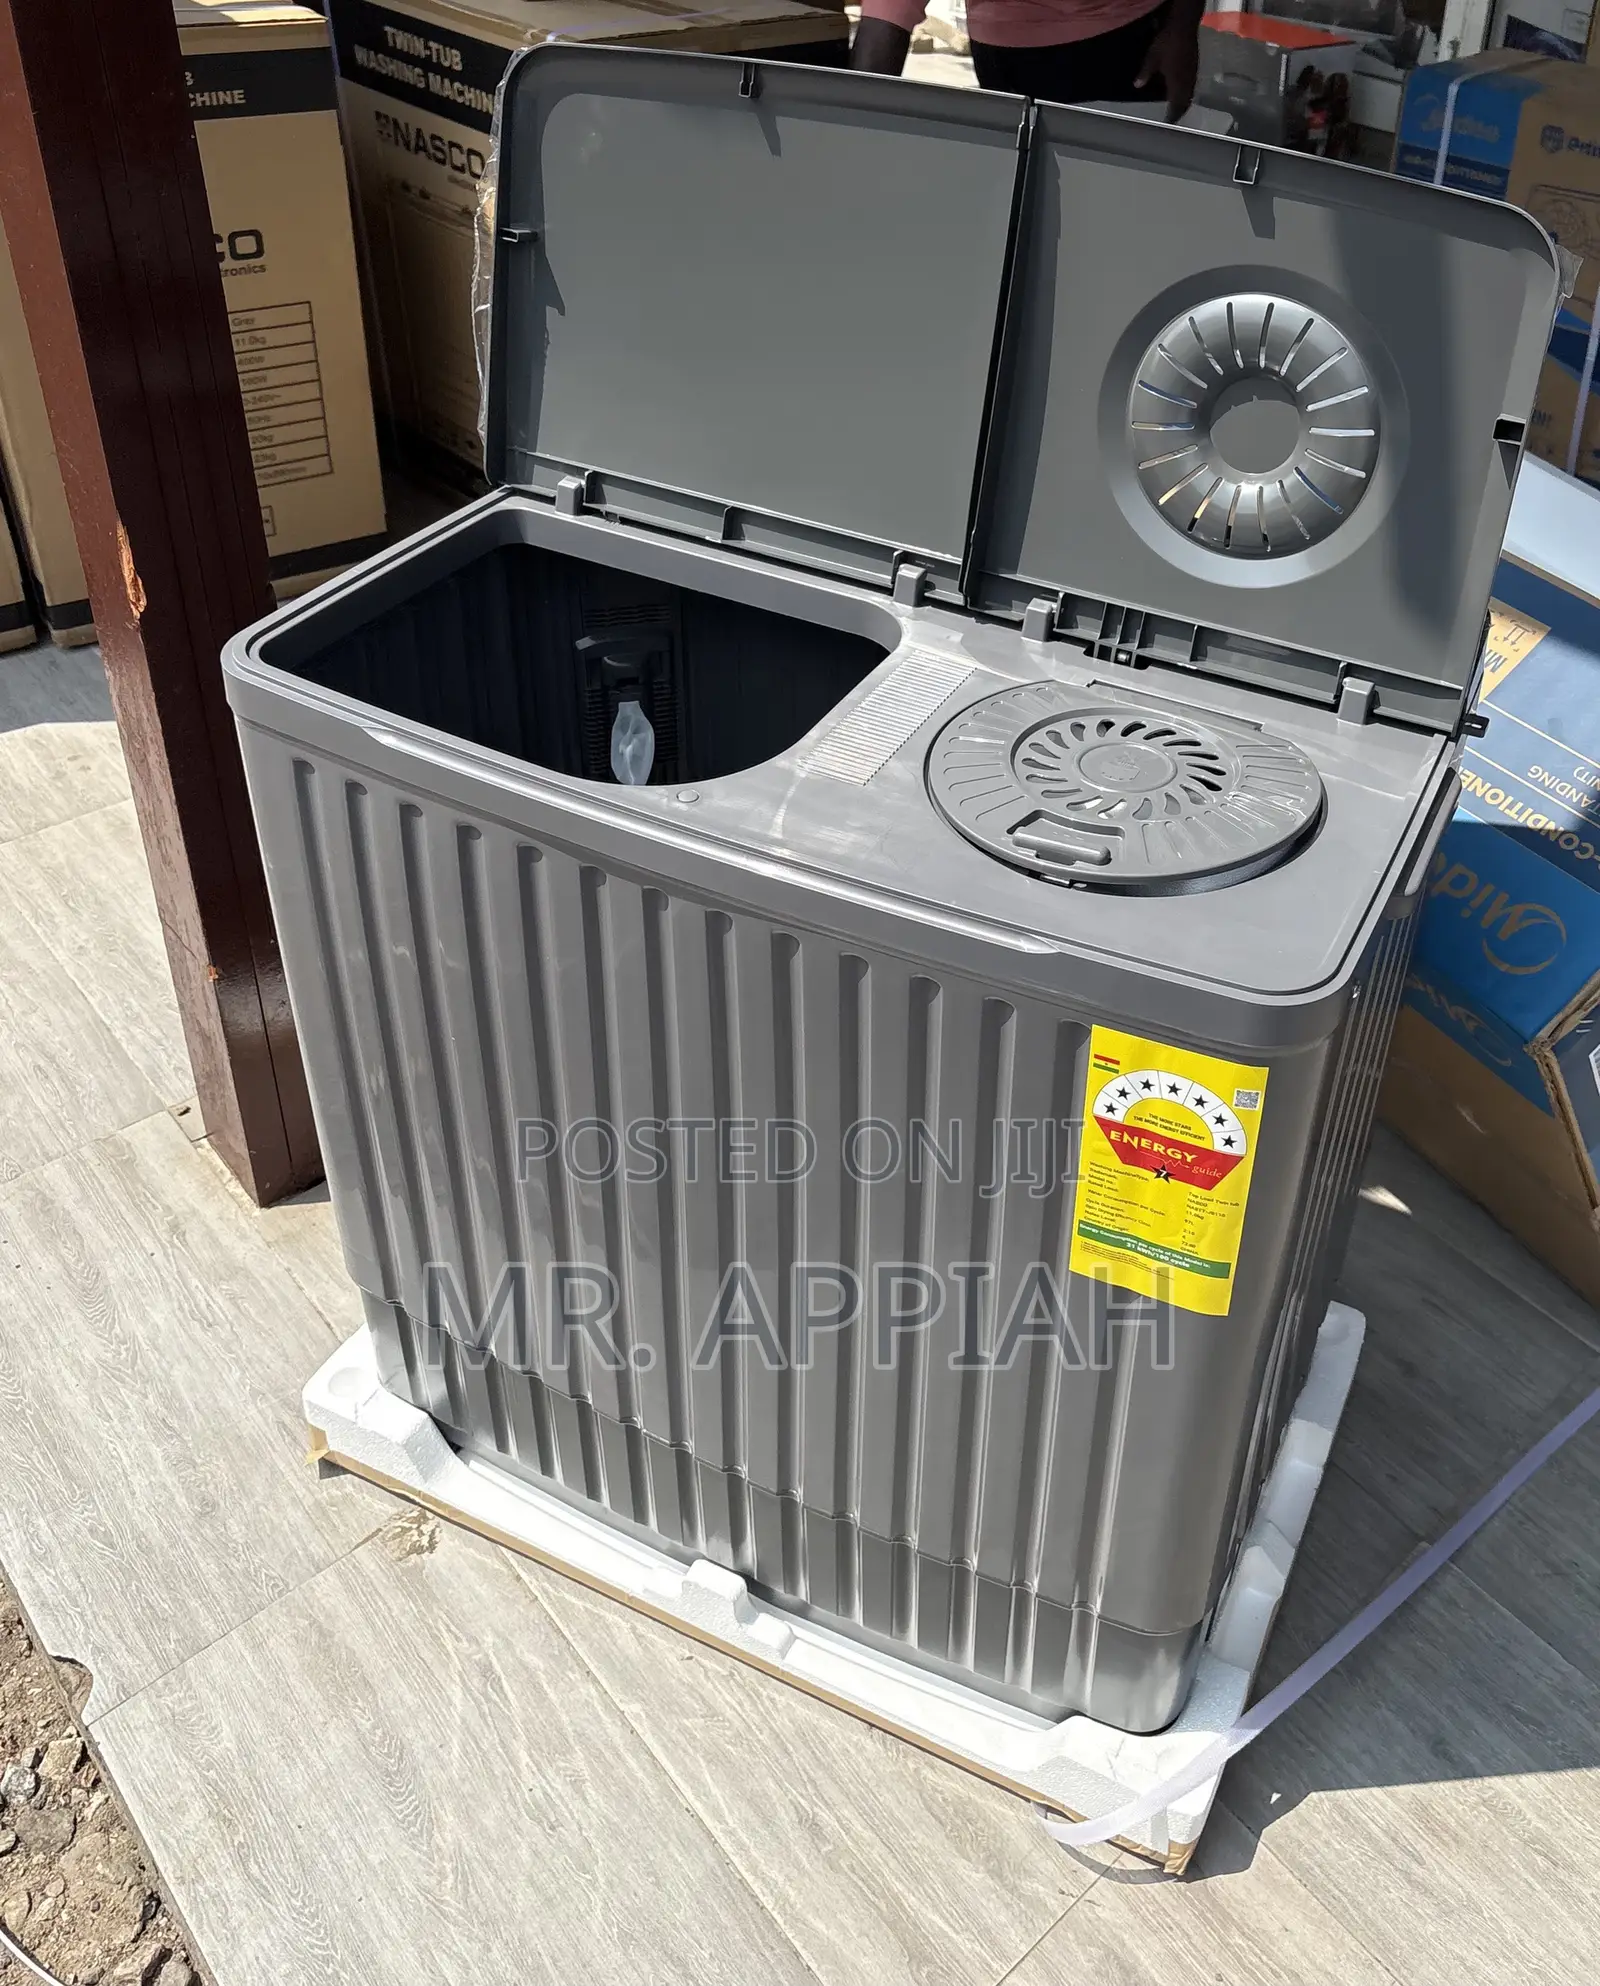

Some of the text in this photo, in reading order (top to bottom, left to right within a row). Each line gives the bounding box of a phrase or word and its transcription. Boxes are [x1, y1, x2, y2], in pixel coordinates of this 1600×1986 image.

[384, 26, 463, 71] TWIN-TUB
[354, 44, 494, 115] WASHING MACHIN
[392, 117, 486, 180] NASCO
[1459, 766, 1600, 871] -CONDITIONE
[1109, 1130, 1198, 1163] ENERGY
[1159, 1169, 1167, 1177] 7
[1192, 1164, 1223, 1179] guide
